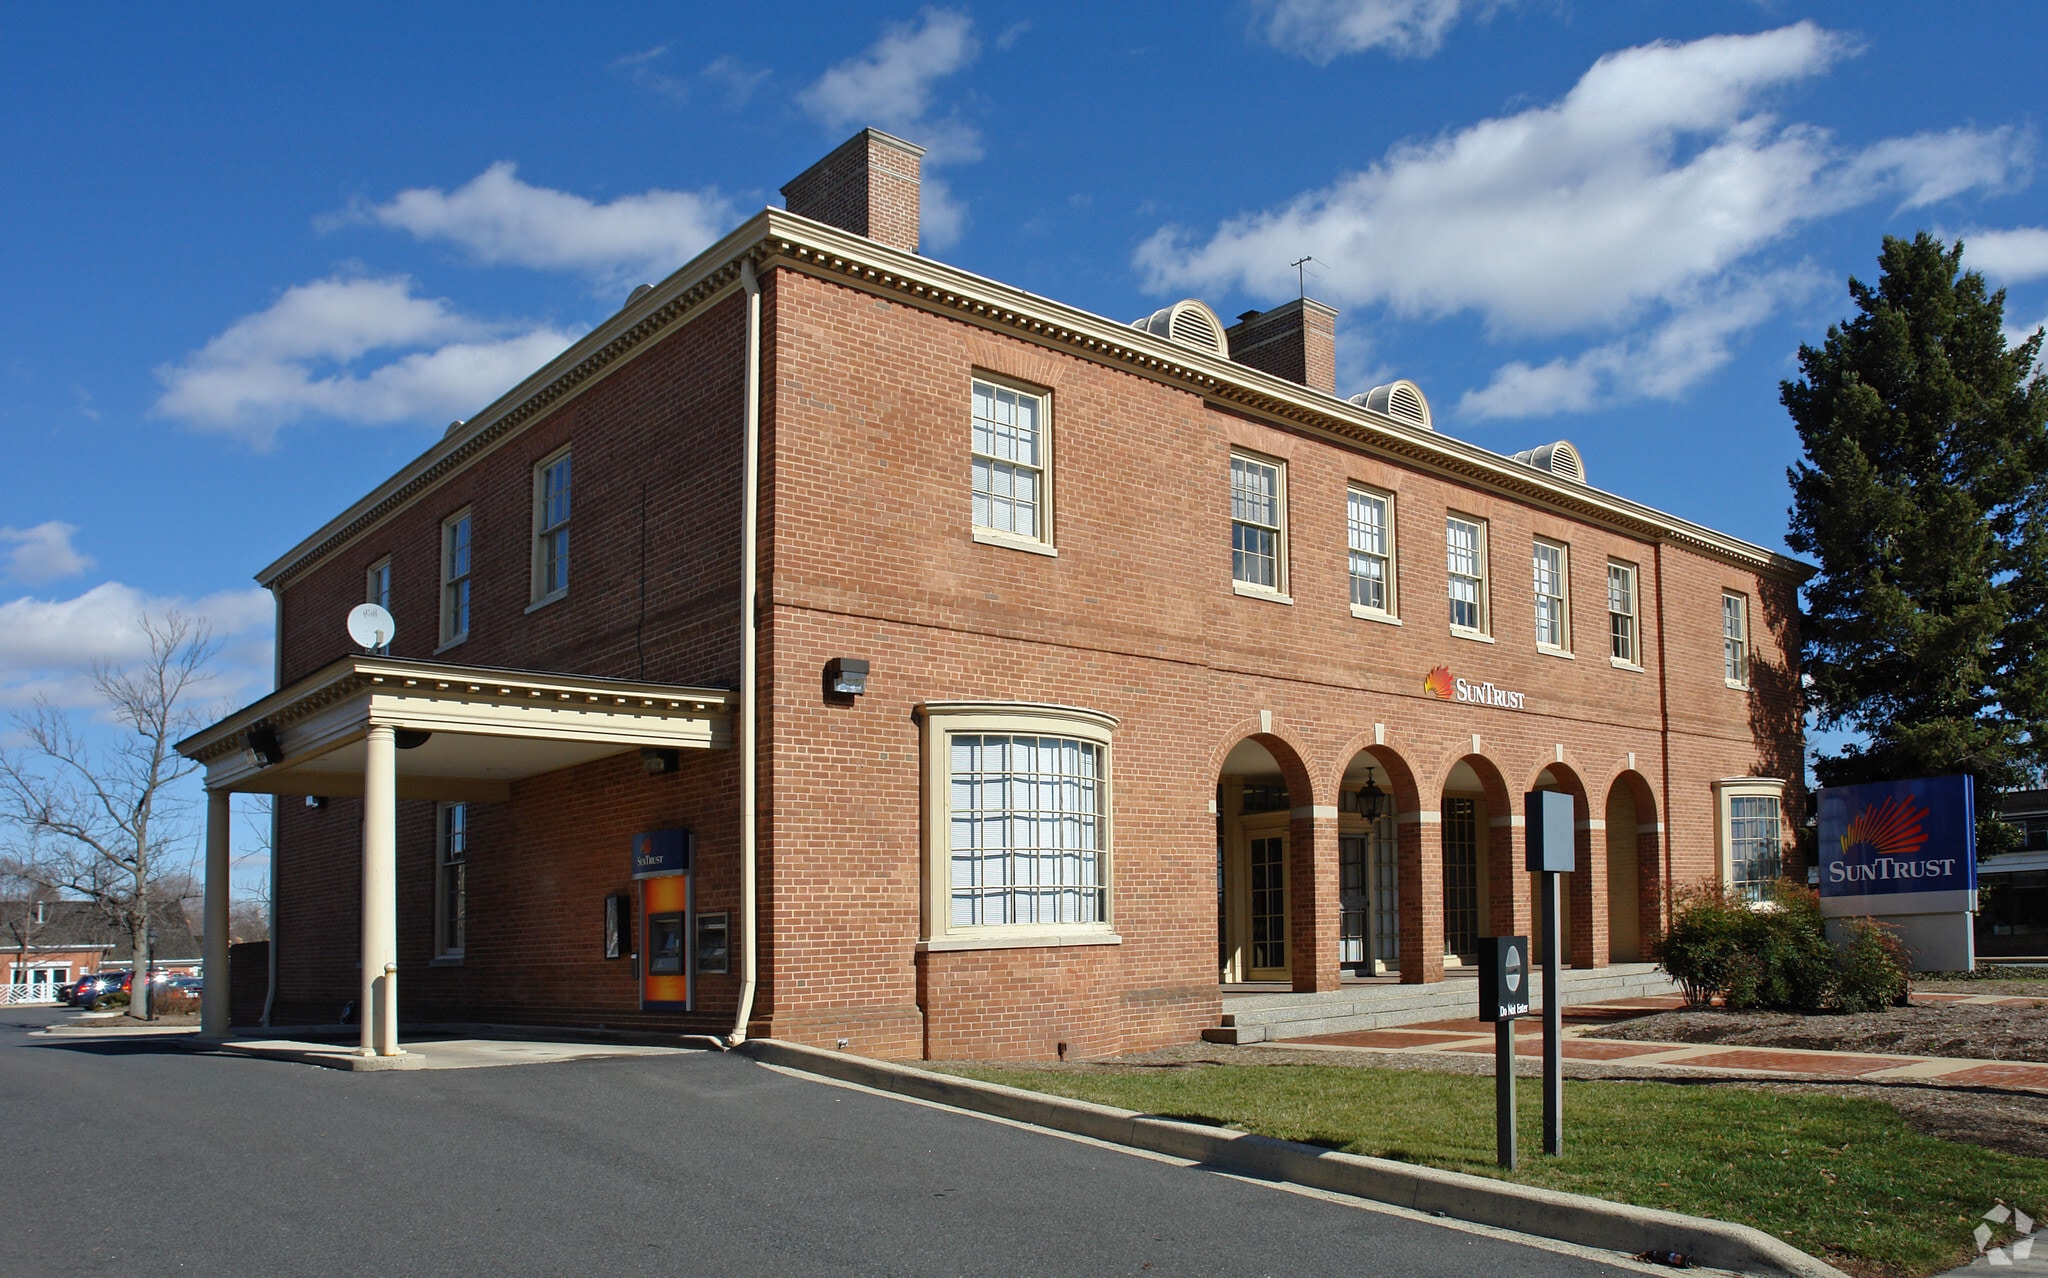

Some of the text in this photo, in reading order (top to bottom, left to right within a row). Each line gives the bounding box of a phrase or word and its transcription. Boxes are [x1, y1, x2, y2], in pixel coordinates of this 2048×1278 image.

[1500, 1002, 1528, 1016] Do Not Enter
